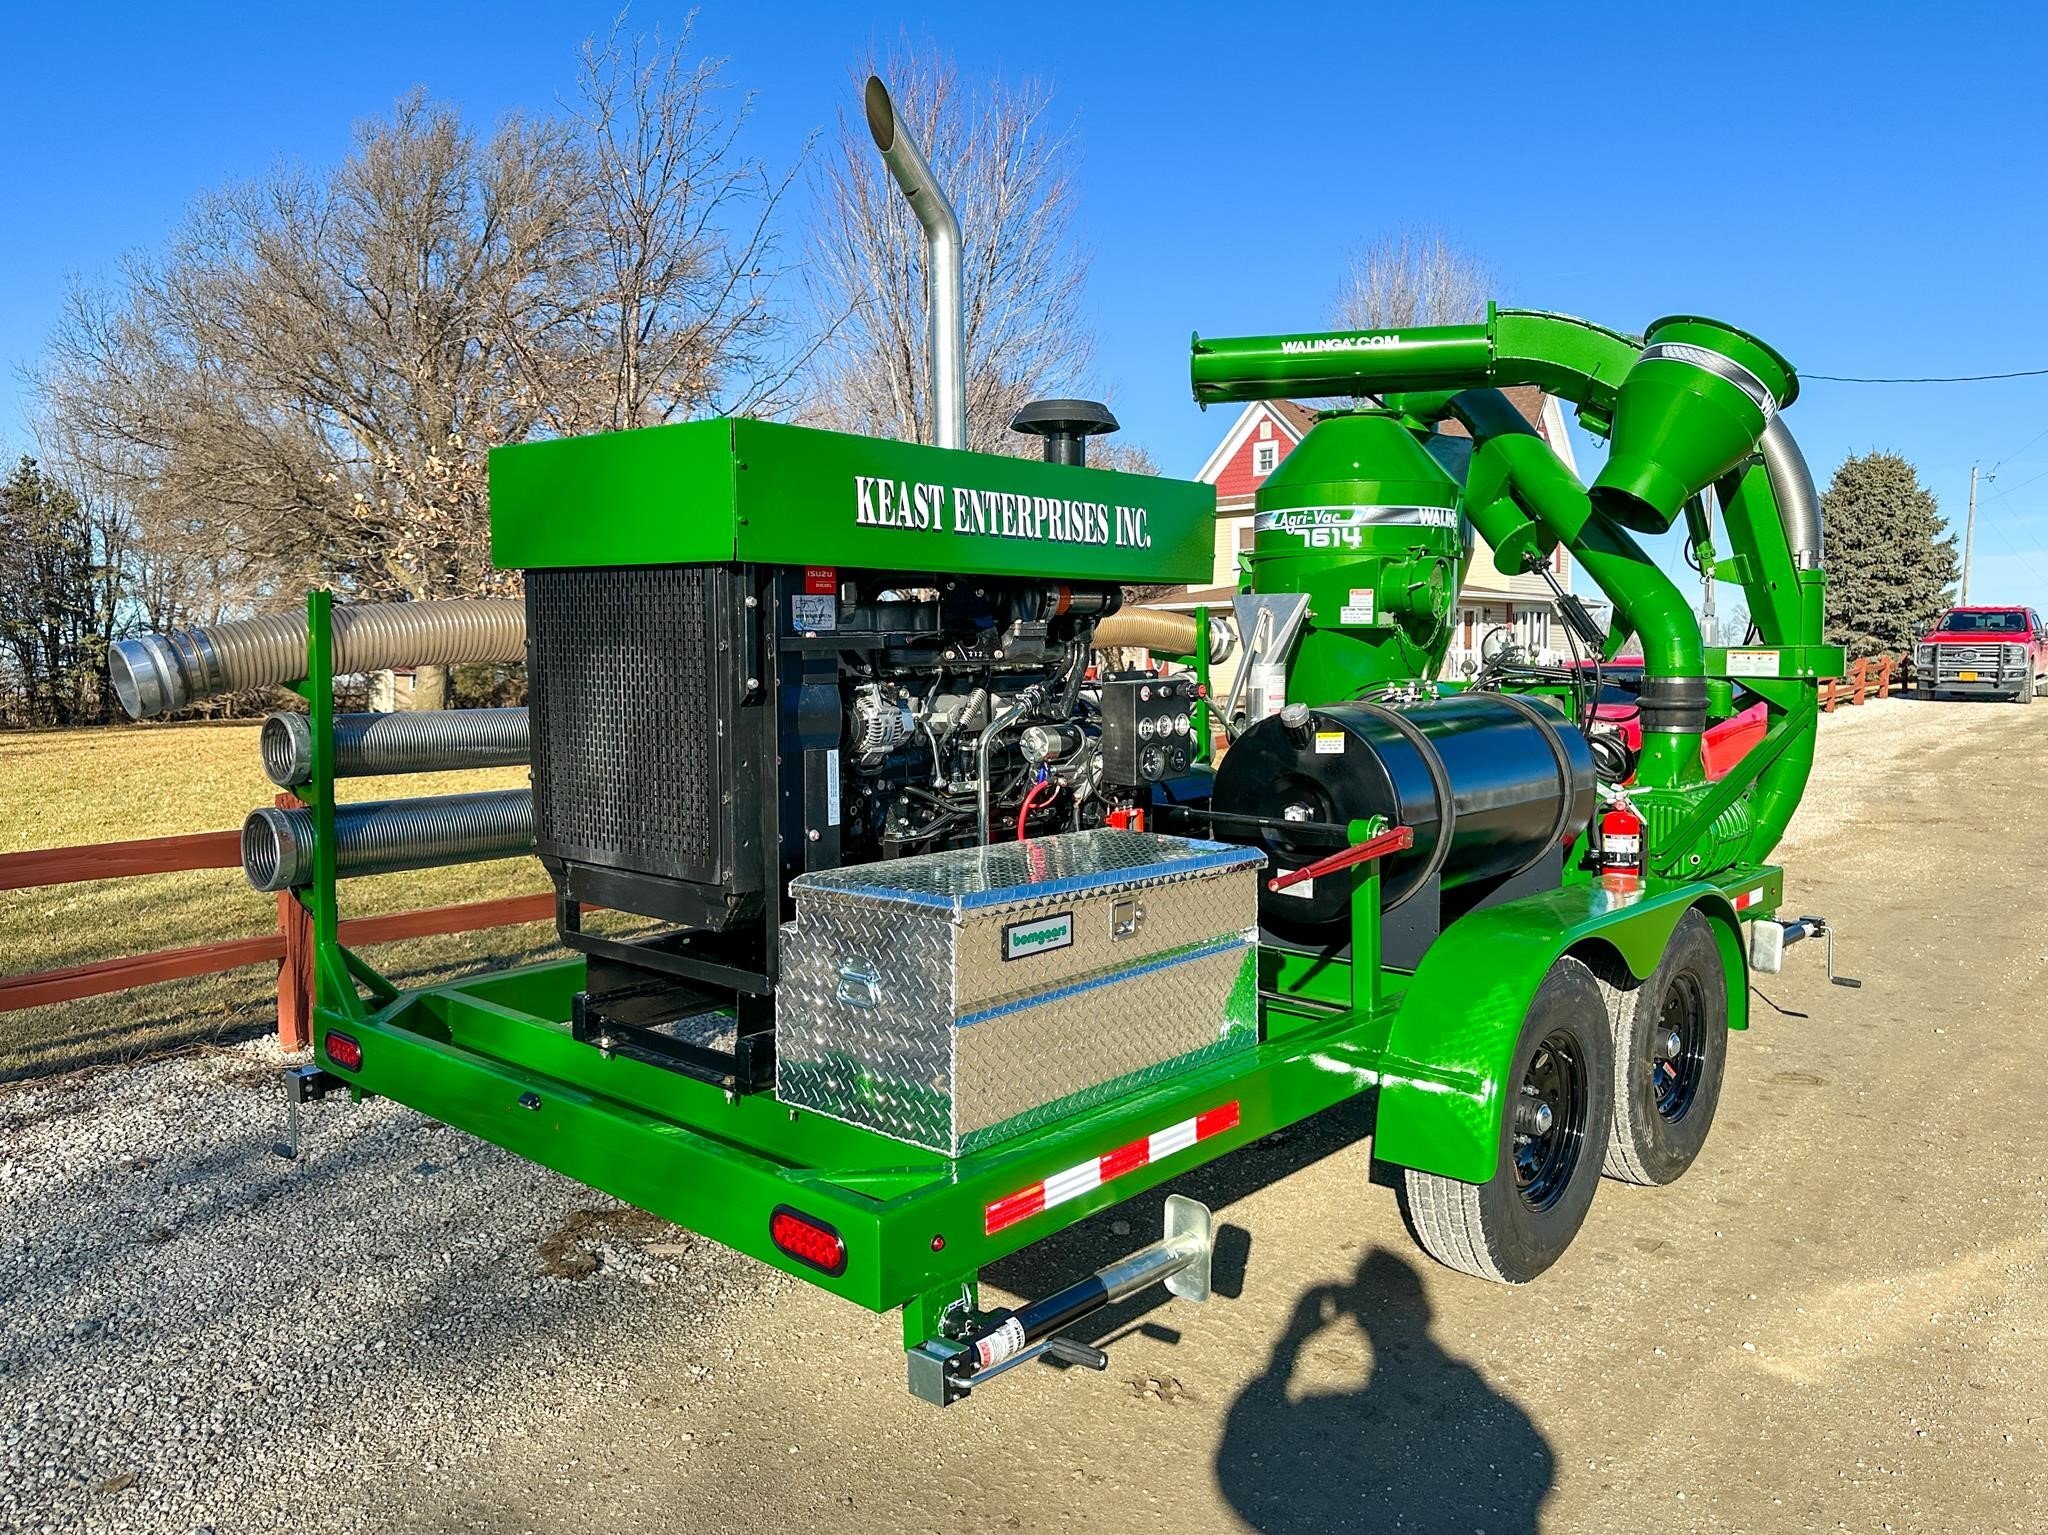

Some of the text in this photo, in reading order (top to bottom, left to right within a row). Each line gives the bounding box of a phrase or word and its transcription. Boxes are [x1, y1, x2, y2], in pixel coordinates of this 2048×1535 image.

[855, 476, 1151, 549] KEAST ENTERPRISES INC.
[1279, 509, 1341, 534] Agri-Vac
[1294, 527, 1362, 548] 7614
